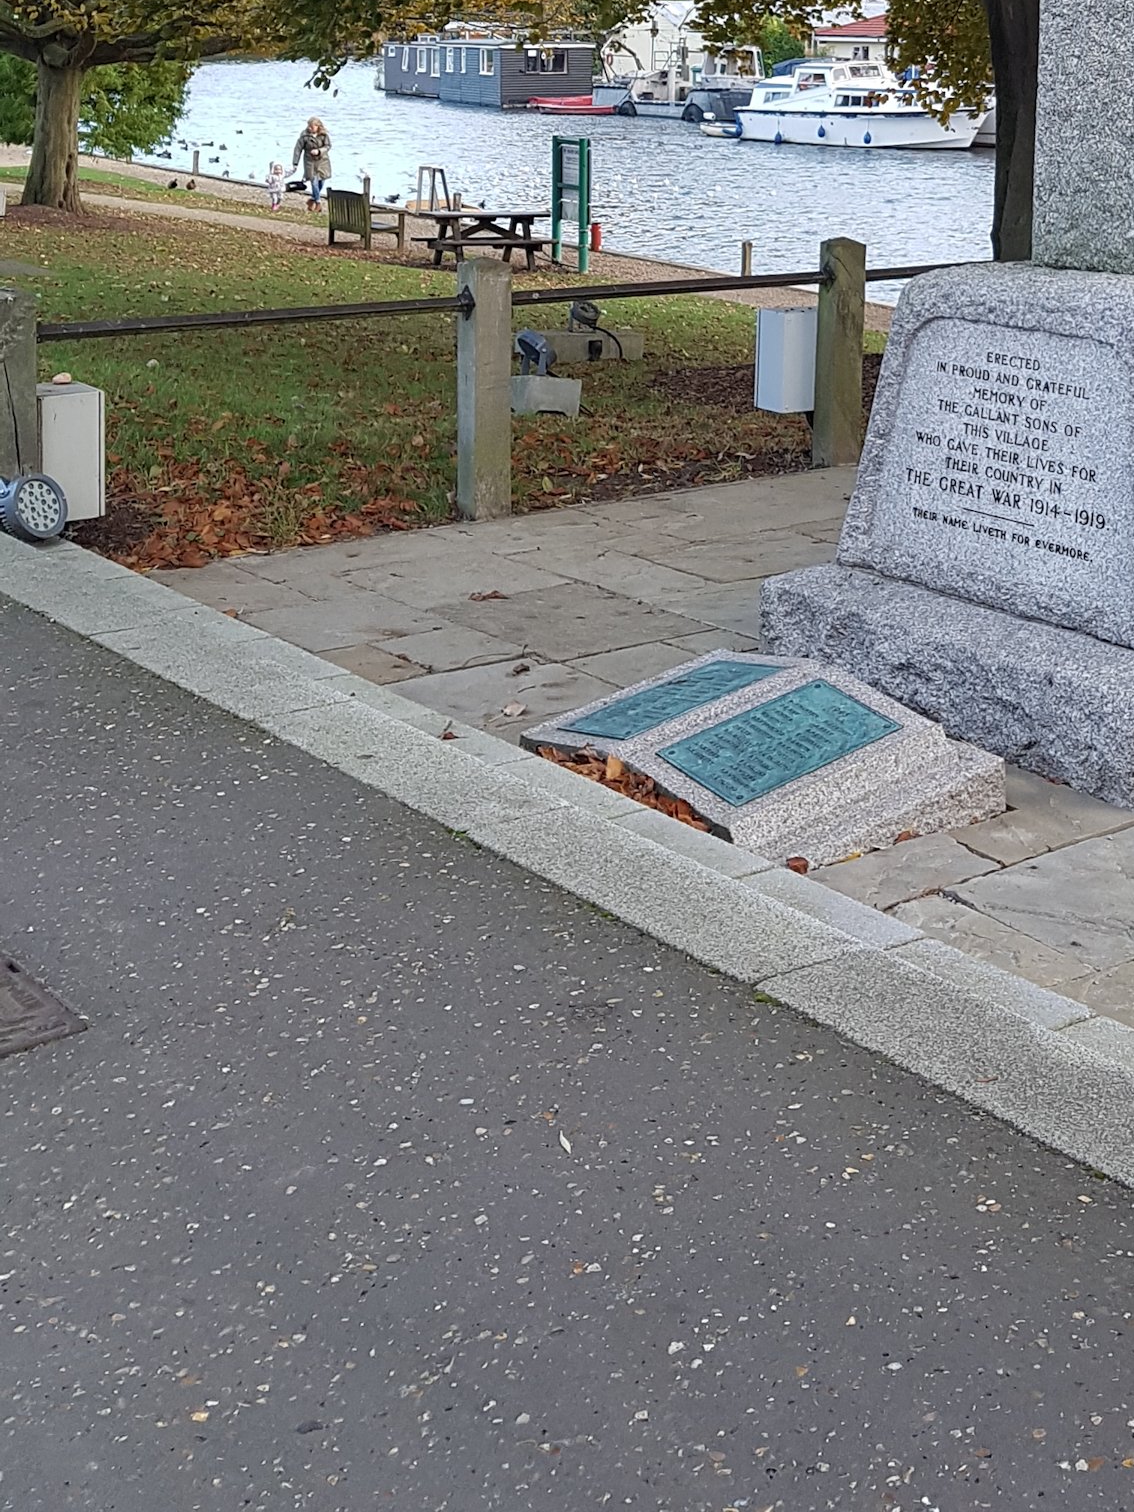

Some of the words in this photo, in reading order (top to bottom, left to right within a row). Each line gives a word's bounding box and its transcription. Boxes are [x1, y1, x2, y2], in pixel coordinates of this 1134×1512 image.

[936, 361, 948, 374] IN
[952, 364, 990, 382] PROUD
[995, 373, 1020, 388] AND
[1026, 378, 1090, 400] GRATEFUL
[986, 352, 1041, 372] ERECTED
[938, 399, 960, 415] THE
[964, 404, 1019, 427] GALLANT
[1025, 417, 1058, 434] SONS
[1064, 425, 1083, 438] OF
[972, 388, 1026, 407] MEMORY
[1030, 398, 1048, 412] OF
[915, 430, 942, 447] WHO
[947, 438, 978, 456] GAVE
[985, 447, 1020, 466] THEIR
[1026, 455, 1064, 476] LIVES
[1072, 466, 1097, 483] FOR
[963, 423, 989, 439] THIS
[995, 430, 1049, 452] VILLAGE
[906, 468, 932, 487] THE
[939, 476, 985, 500] GREAT
[992, 489, 1022, 510] WAR
[945, 457, 979, 475] THEIR
[984, 466, 1044, 490] COUNTRY
[1049, 481, 1062, 496] IN
[912, 507, 938, 522] THEIR
[942, 516, 968, 530] NAME
[972, 523, 1007, 541] LIVETH
[1011, 533, 1030, 546] FOR
